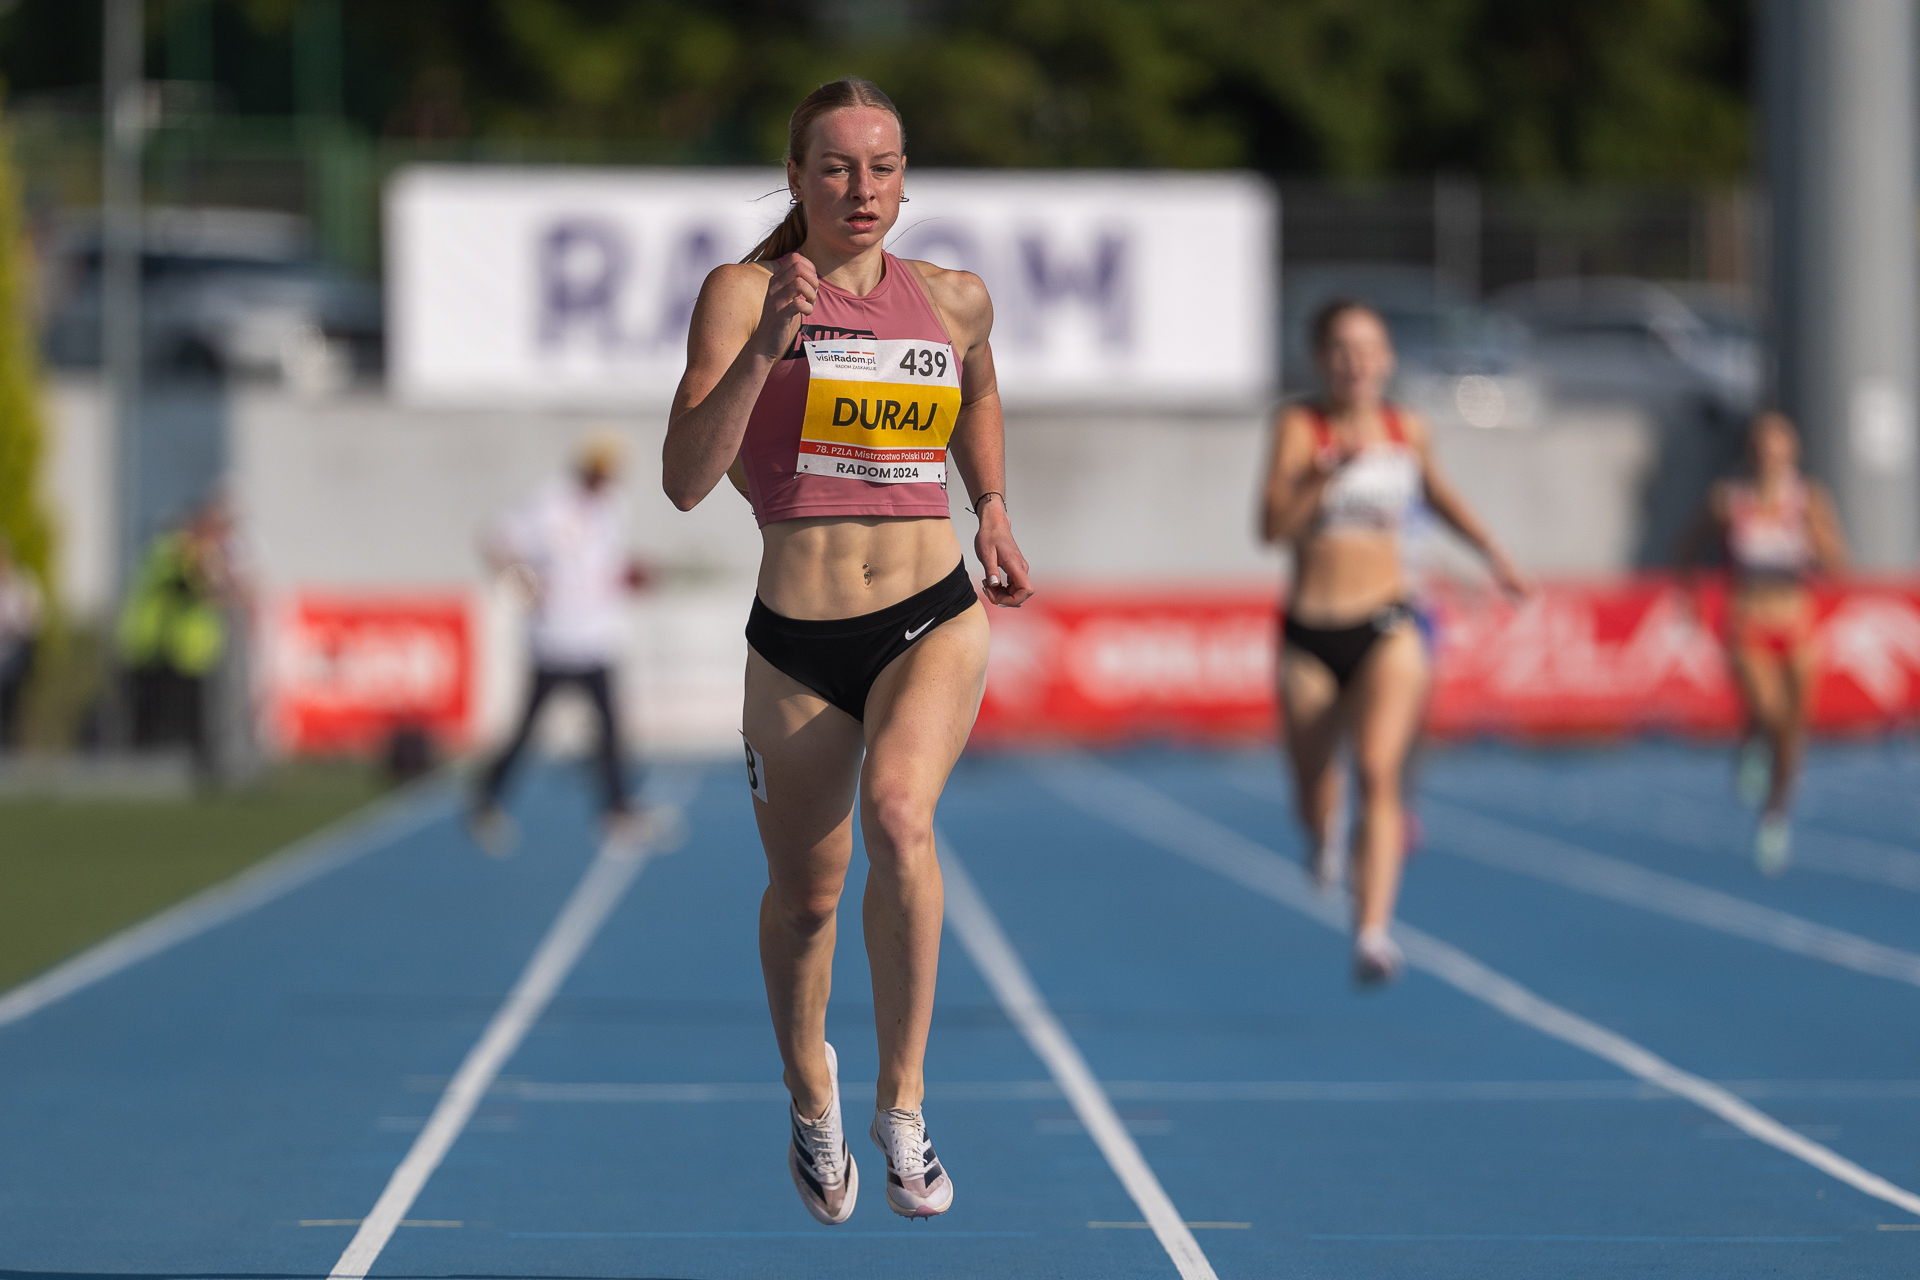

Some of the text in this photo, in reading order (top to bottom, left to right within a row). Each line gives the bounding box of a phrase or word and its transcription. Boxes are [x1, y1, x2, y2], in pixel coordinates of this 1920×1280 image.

[540, 220, 1136, 350] RAM
[815, 354, 876, 366] visitRadom.pl
[900, 348, 947, 378] 439
[832, 397, 938, 431] DURAJ
[815, 445, 829, 454] 78.
[854, 450, 901, 461] Mistrzostwa
[901, 451, 920, 460] Polski
[920, 452, 935, 460] U20
[836, 462, 919, 478] RADOM 2024
